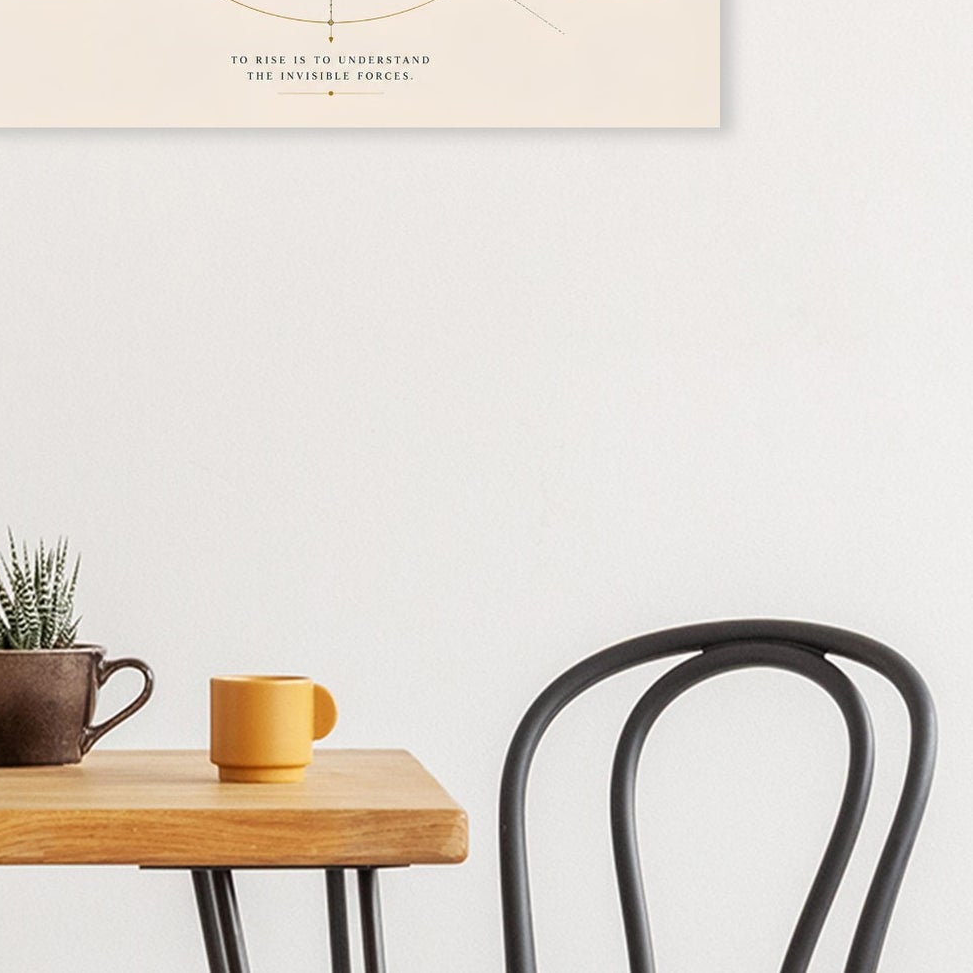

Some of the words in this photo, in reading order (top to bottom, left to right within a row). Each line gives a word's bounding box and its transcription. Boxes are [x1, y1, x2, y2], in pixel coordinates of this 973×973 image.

[231, 55, 248, 65] TO
[255, 55, 286, 65] RISE
[293, 55, 306, 65] IS
[313, 55, 331, 65] TO
[338, 55, 430, 65] UNDERSTAND
[247, 71, 273, 81] THE
[280, 71, 350, 81] INVISIBLE
[357, 71, 415, 81] FORCES.
